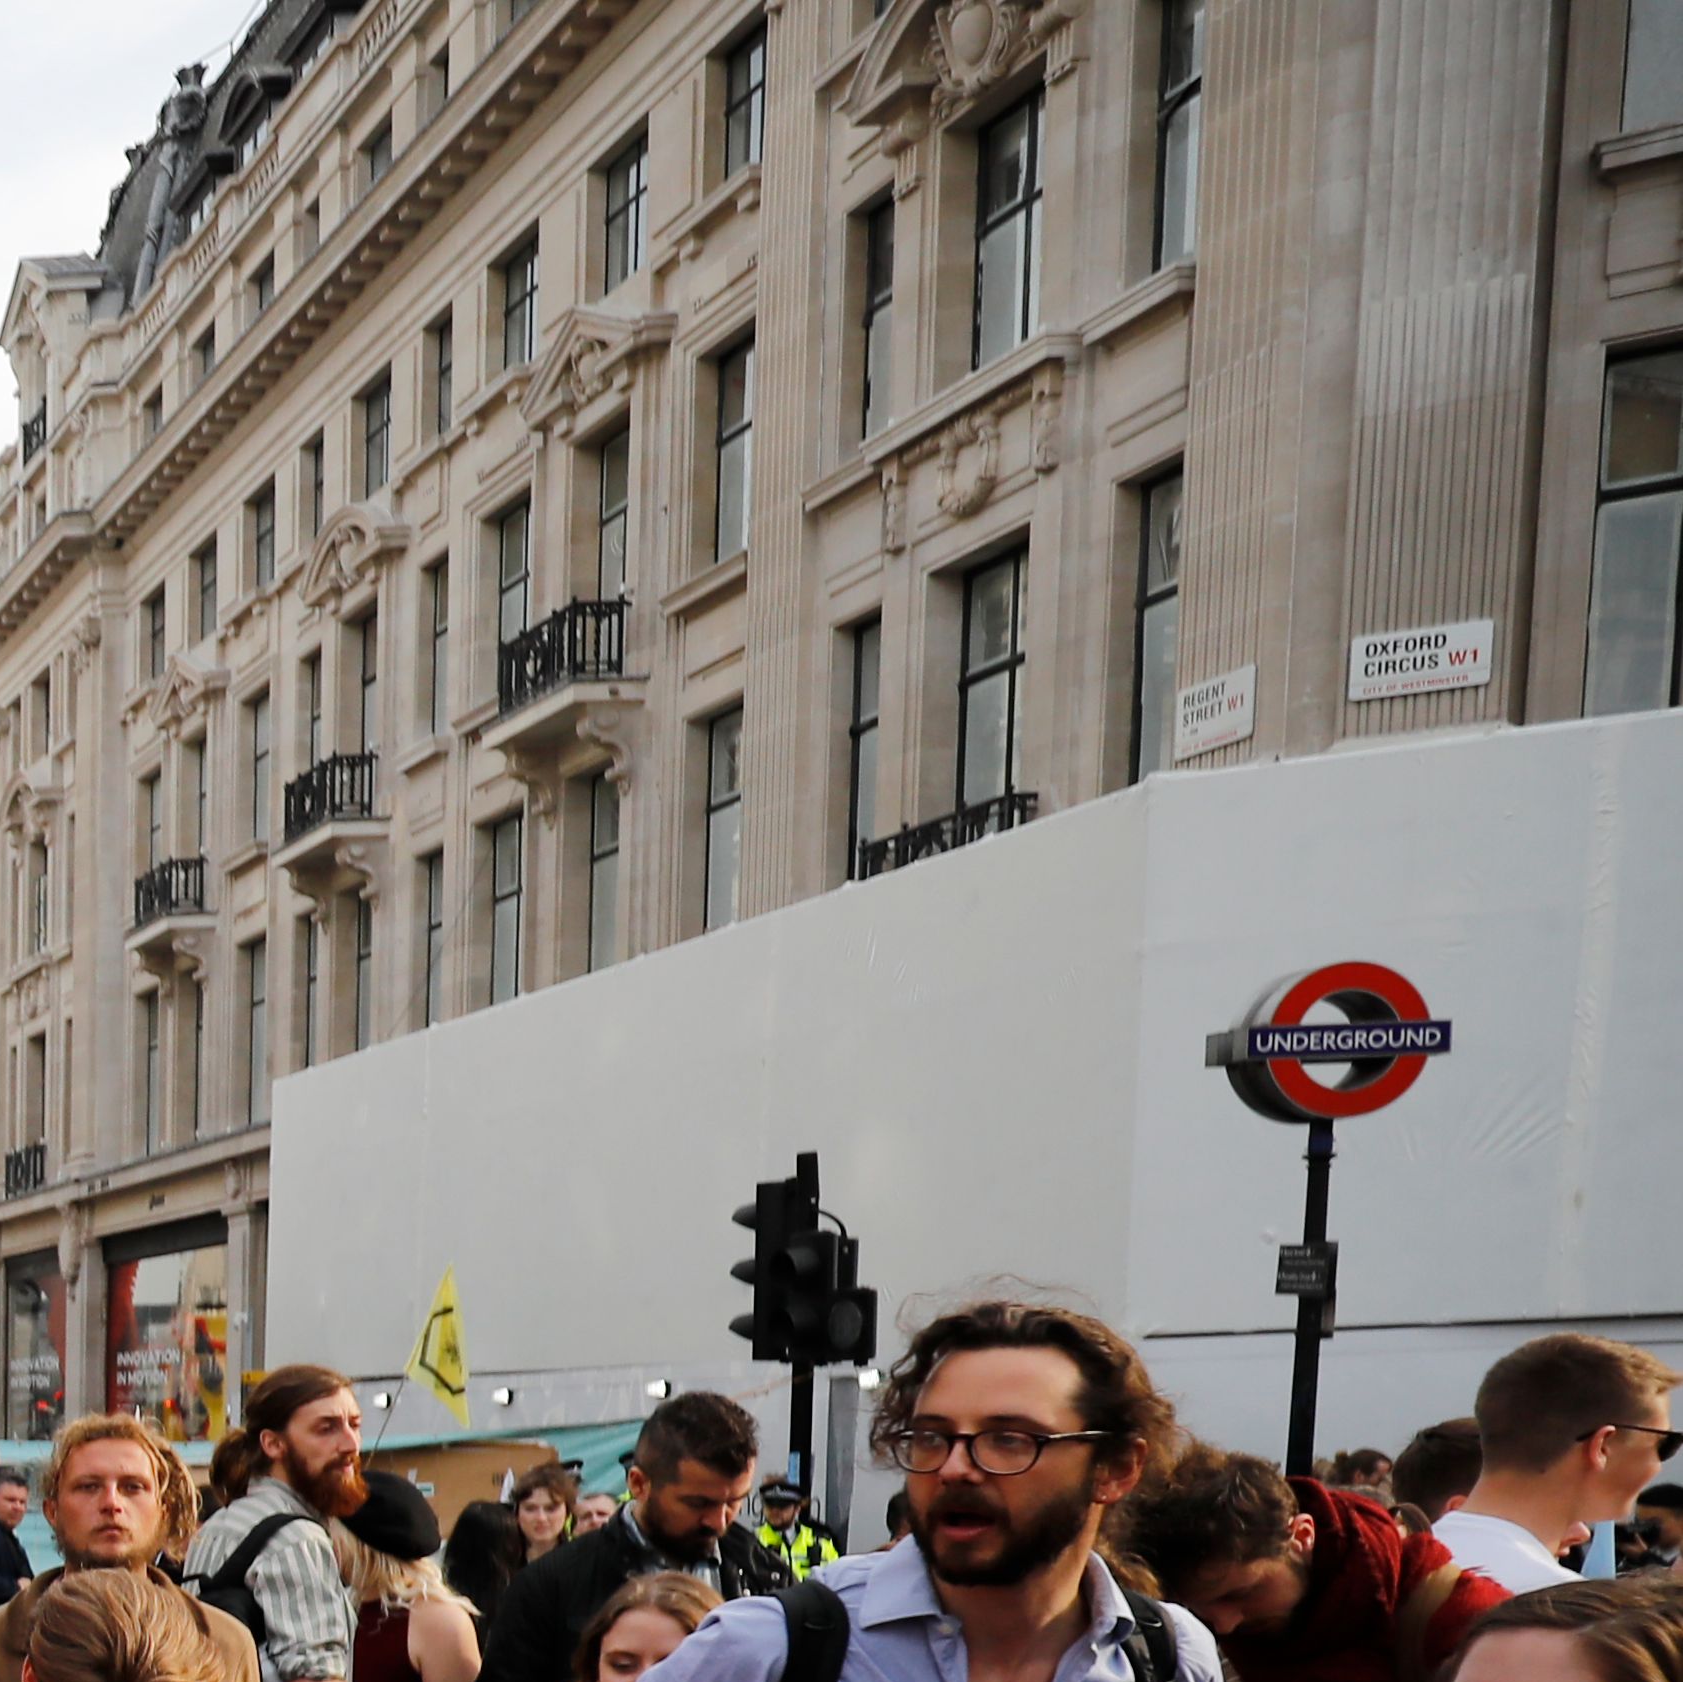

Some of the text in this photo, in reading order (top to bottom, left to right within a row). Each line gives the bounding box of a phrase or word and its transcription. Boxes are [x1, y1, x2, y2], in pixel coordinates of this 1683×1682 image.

[1365, 634, 1447, 658] OXFORD
[1364, 648, 1479, 677] CIRCUS W1
[1183, 681, 1226, 709] REGENT
[1363, 674, 1469, 696] CITY OF WESTMINSTER
[1183, 692, 1244, 728] STREET W1
[1256, 1027, 1441, 1053] UNDERGROUND
[10, 1355, 59, 1371] INNOVATION
[116, 1349, 181, 1367] INNOVATION
[116, 1369, 168, 1386] IN MOTION
